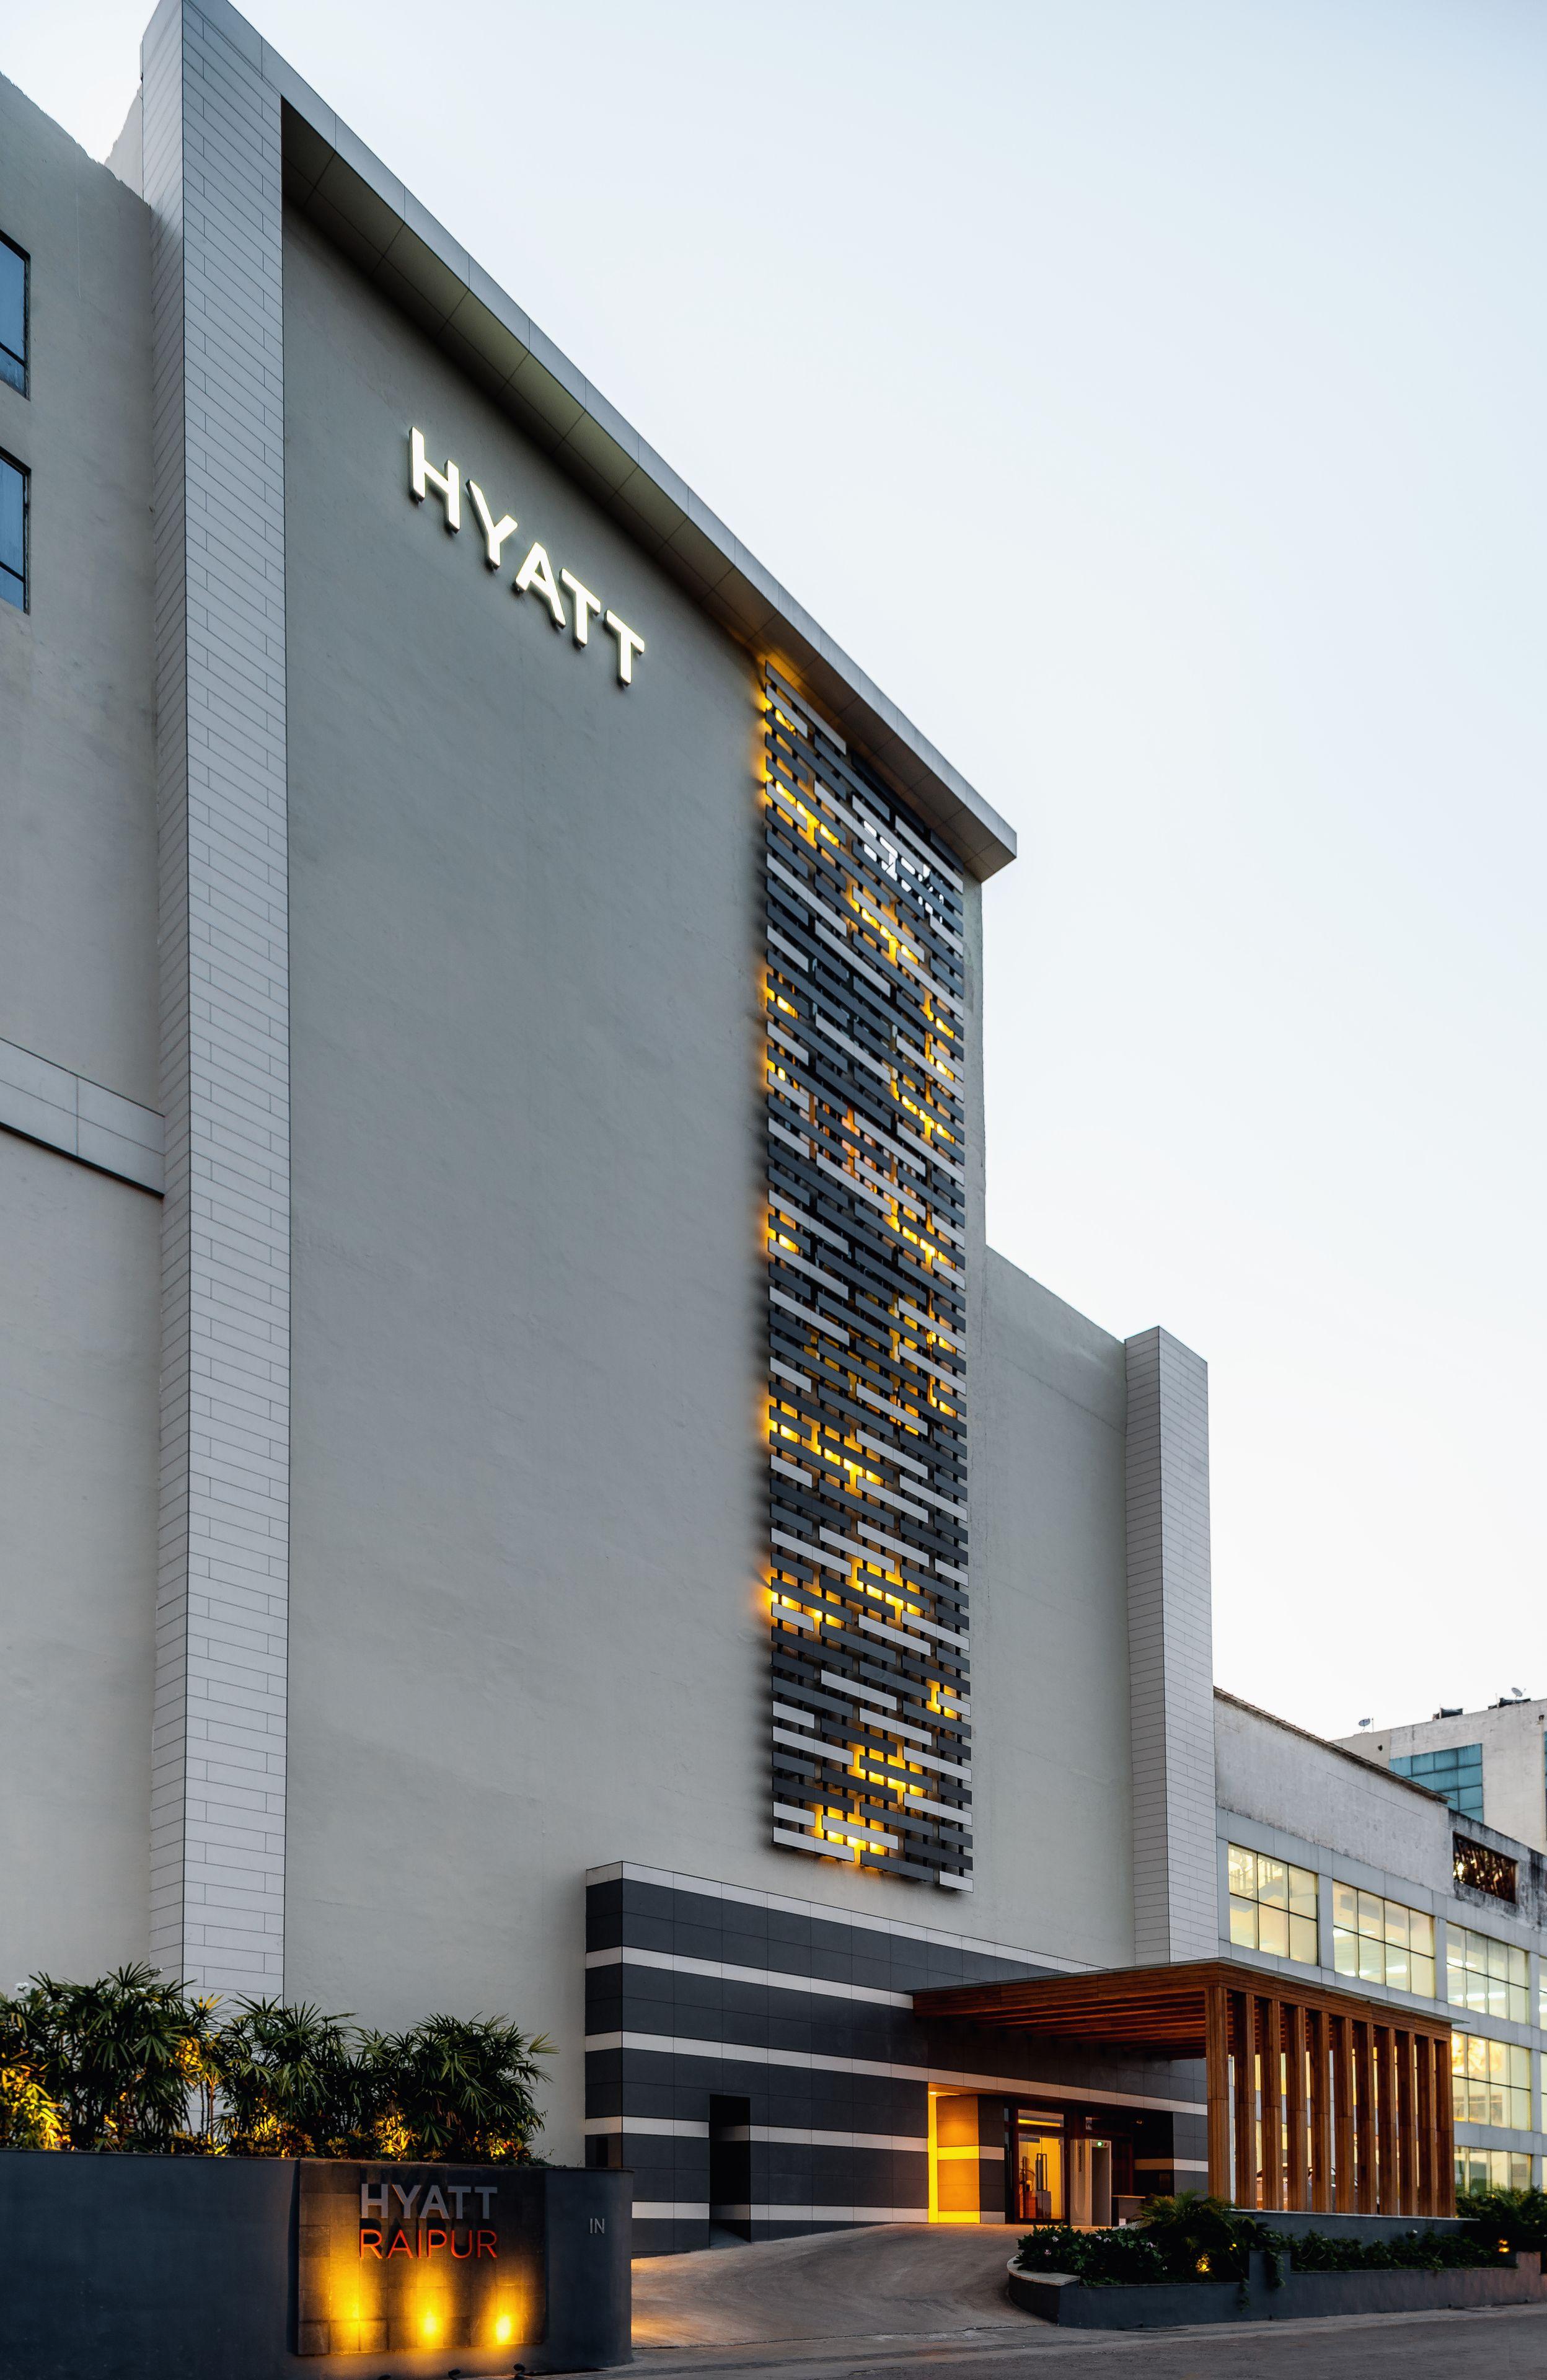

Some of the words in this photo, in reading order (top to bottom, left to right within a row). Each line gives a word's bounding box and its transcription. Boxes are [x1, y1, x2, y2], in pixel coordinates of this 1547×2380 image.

[410, 426, 645, 684] HYATT
[361, 2183, 497, 2219] HYATT
[589, 2218, 606, 2234] IN
[359, 2228, 498, 2259] RAIPUR
